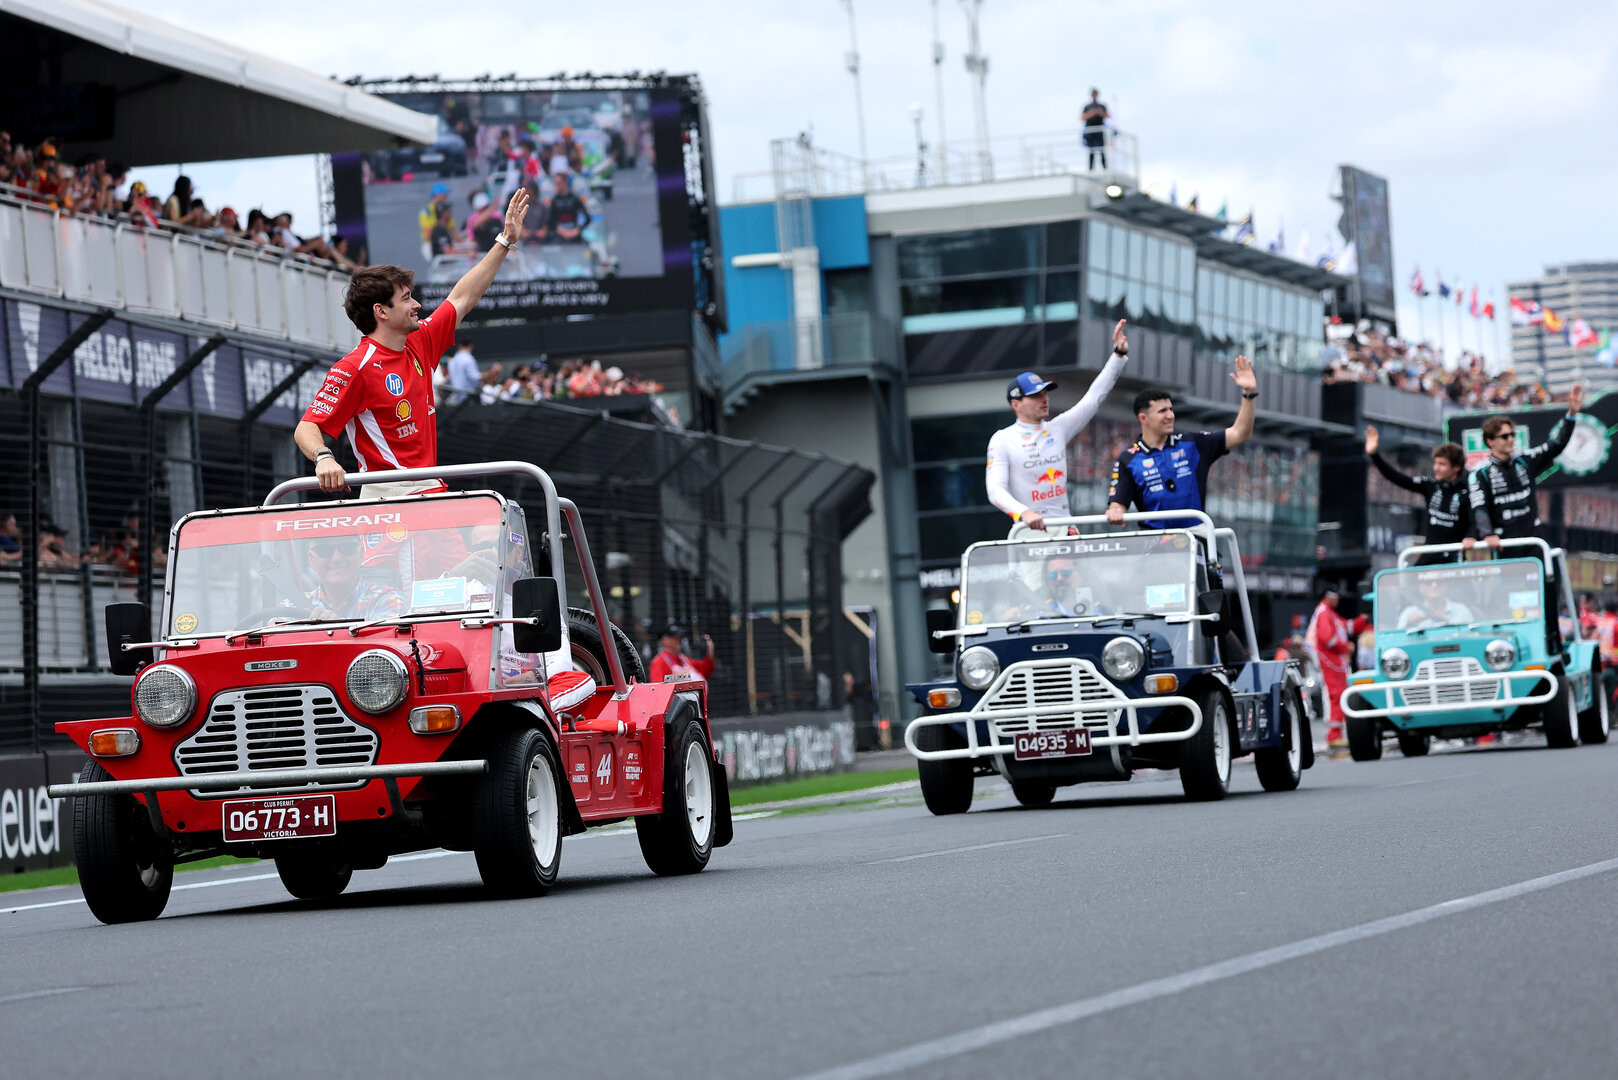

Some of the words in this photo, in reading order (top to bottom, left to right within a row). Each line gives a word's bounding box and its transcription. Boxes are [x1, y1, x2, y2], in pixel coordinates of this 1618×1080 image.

[396, 422, 419, 439] IBM
[275, 512, 402, 533] FERRARI
[1028, 545, 1072, 557] RED
[1074, 542, 1128, 554] BULL
[257, 661, 284, 669] MOKE
[596, 753, 612, 785] 44
[0, 786, 66, 860] euer
[263, 830, 297, 838] VICTORIA
